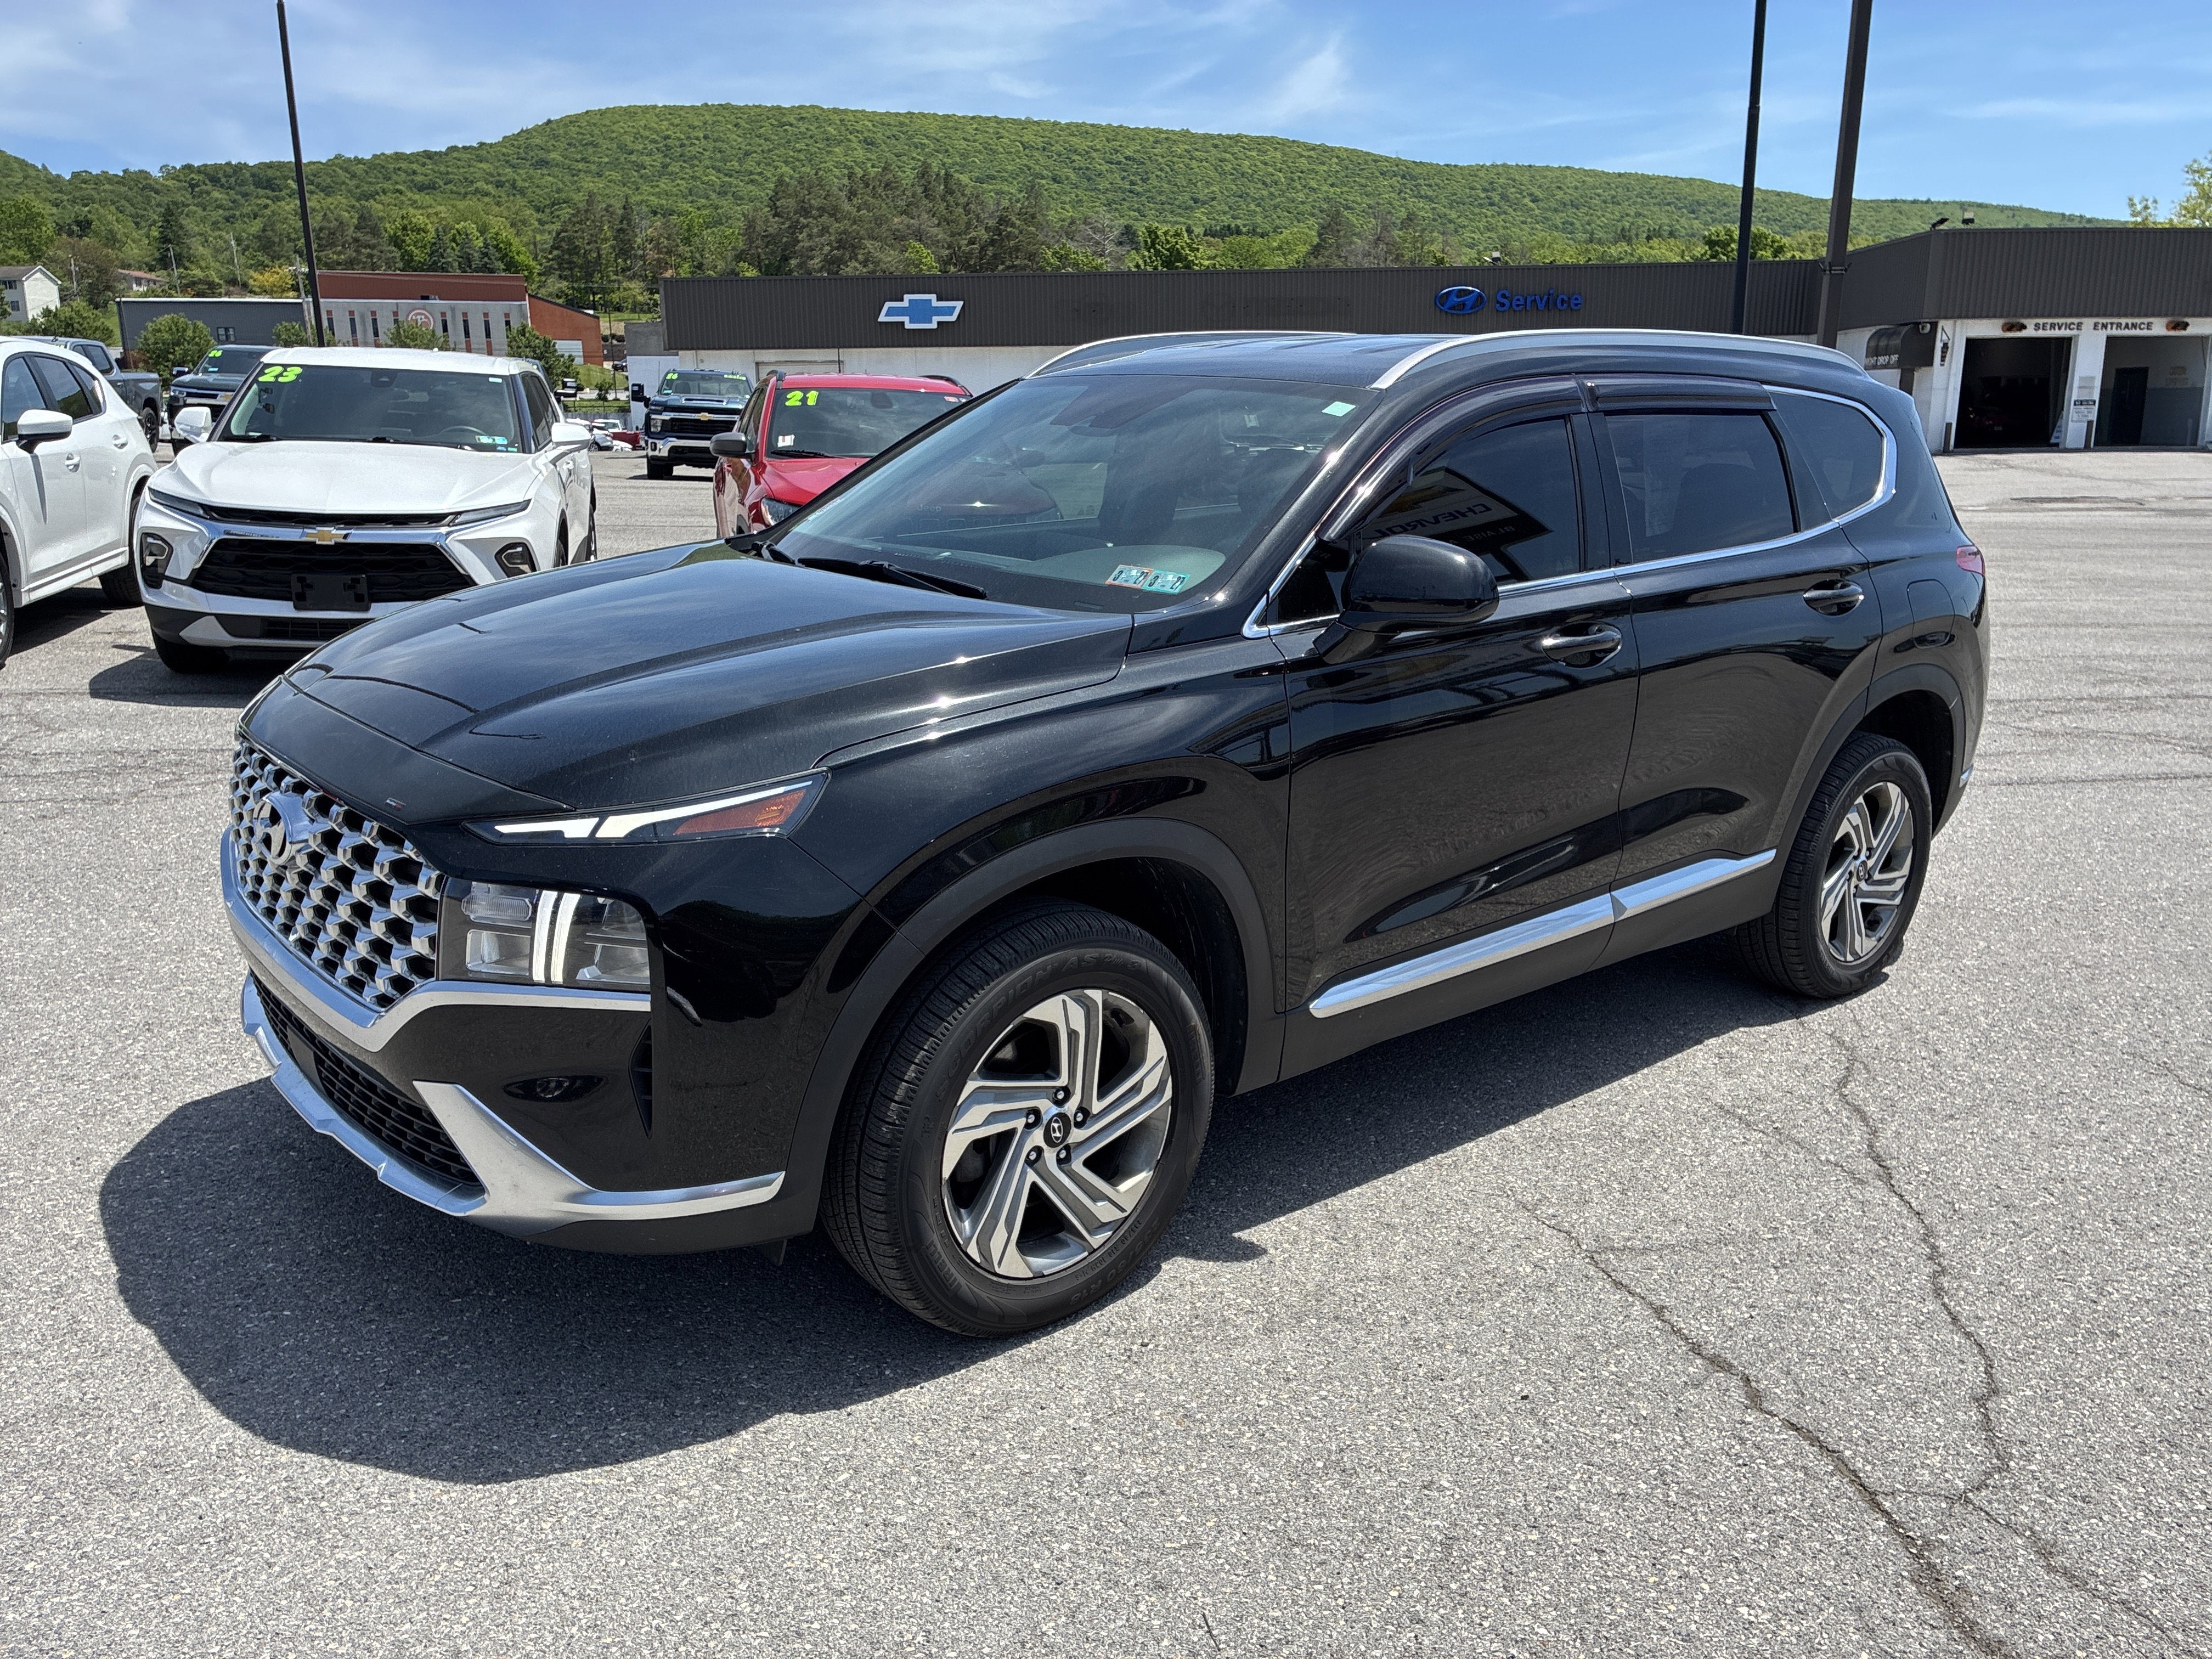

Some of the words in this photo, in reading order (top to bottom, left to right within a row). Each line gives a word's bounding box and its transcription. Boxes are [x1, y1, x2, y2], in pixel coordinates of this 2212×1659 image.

[1494, 288, 1583, 312] Service
[2033, 321, 2084, 331] SERVICE
[2092, 321, 2153, 331] ENTRANCE
[258, 365, 303, 383] 23
[785, 391, 819, 406] 21
[1112, 570, 1124, 582] 3
[1148, 575, 1160, 587] 3
